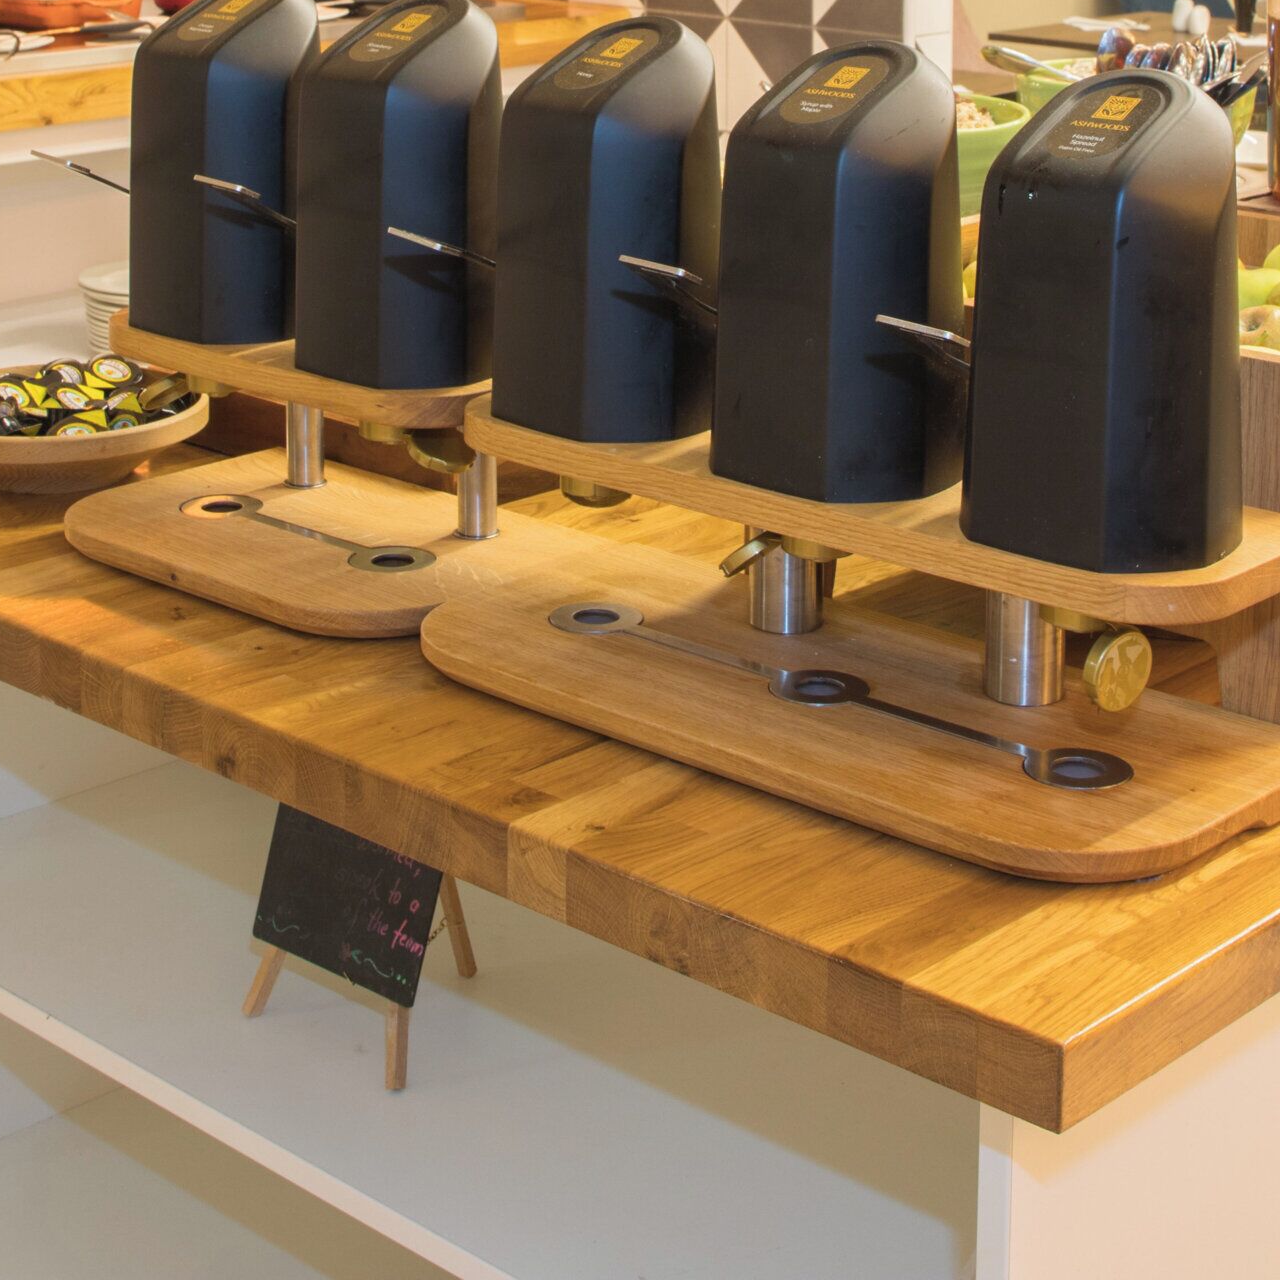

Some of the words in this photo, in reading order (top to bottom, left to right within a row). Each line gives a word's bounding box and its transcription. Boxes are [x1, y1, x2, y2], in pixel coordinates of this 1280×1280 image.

[803, 87, 857, 99] ASHWOODS
[1070, 120, 1131, 132] ASHWOODS
[1070, 139, 1098, 147] Spread
[1072, 133, 1105, 143] Hazelnut
[388, 878, 402, 905] to
[410, 899, 420, 914] a
[391, 919, 424, 956] team
